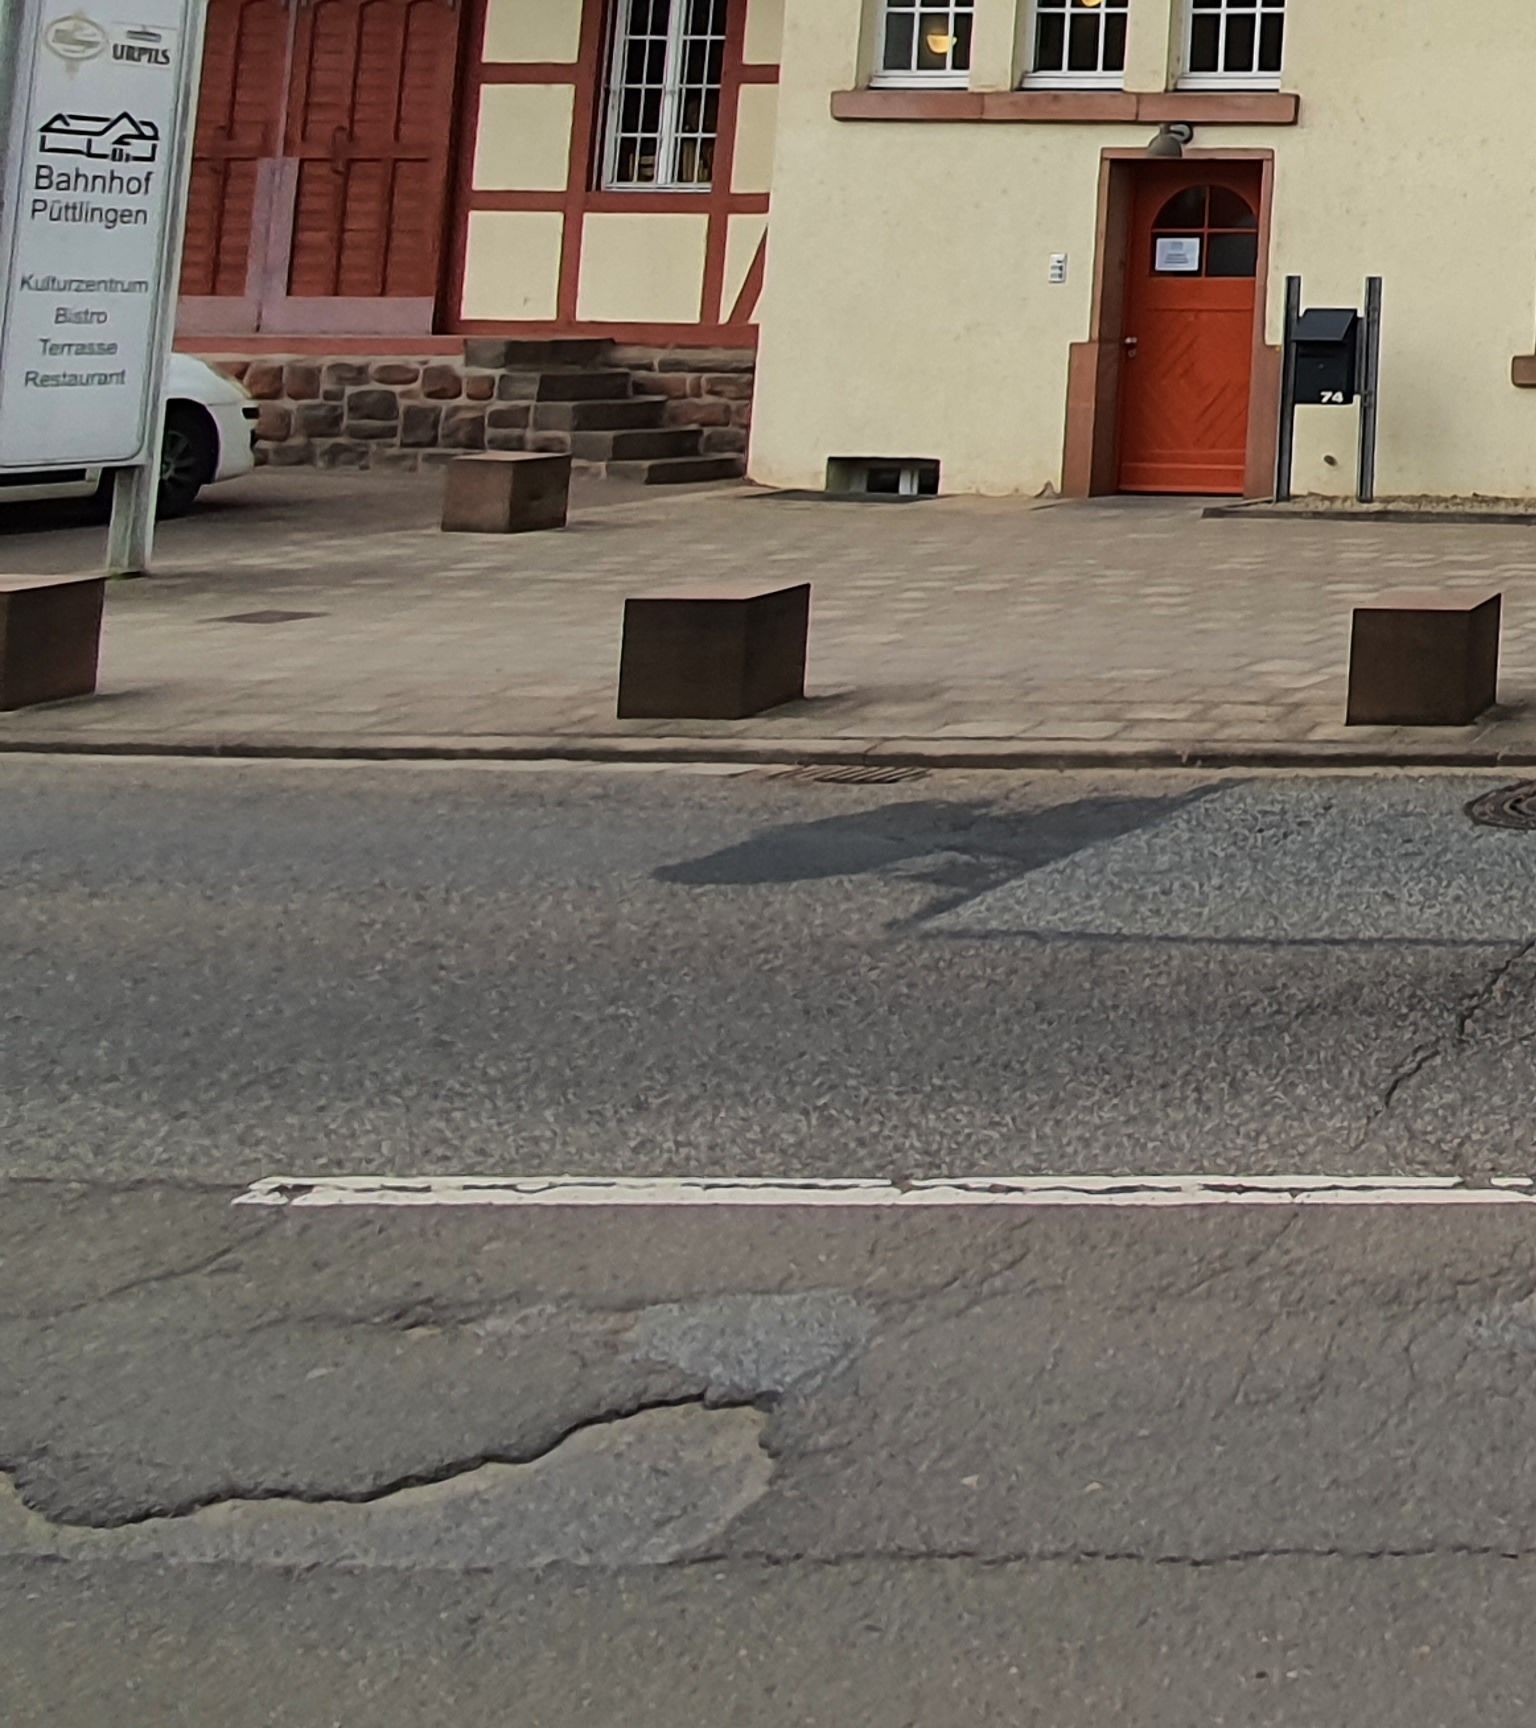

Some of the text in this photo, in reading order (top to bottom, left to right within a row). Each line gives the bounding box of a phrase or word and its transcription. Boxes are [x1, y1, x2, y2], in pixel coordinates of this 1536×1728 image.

[34, 164, 154, 195] Bahnhof
[31, 198, 148, 229] Püttlingen
[20, 274, 149, 293] Kulturzentrum
[54, 306, 108, 324] Bistro
[39, 337, 118, 356] Terrasse
[24, 369, 126, 387] Restaurant
[1320, 390, 1344, 403] 74
